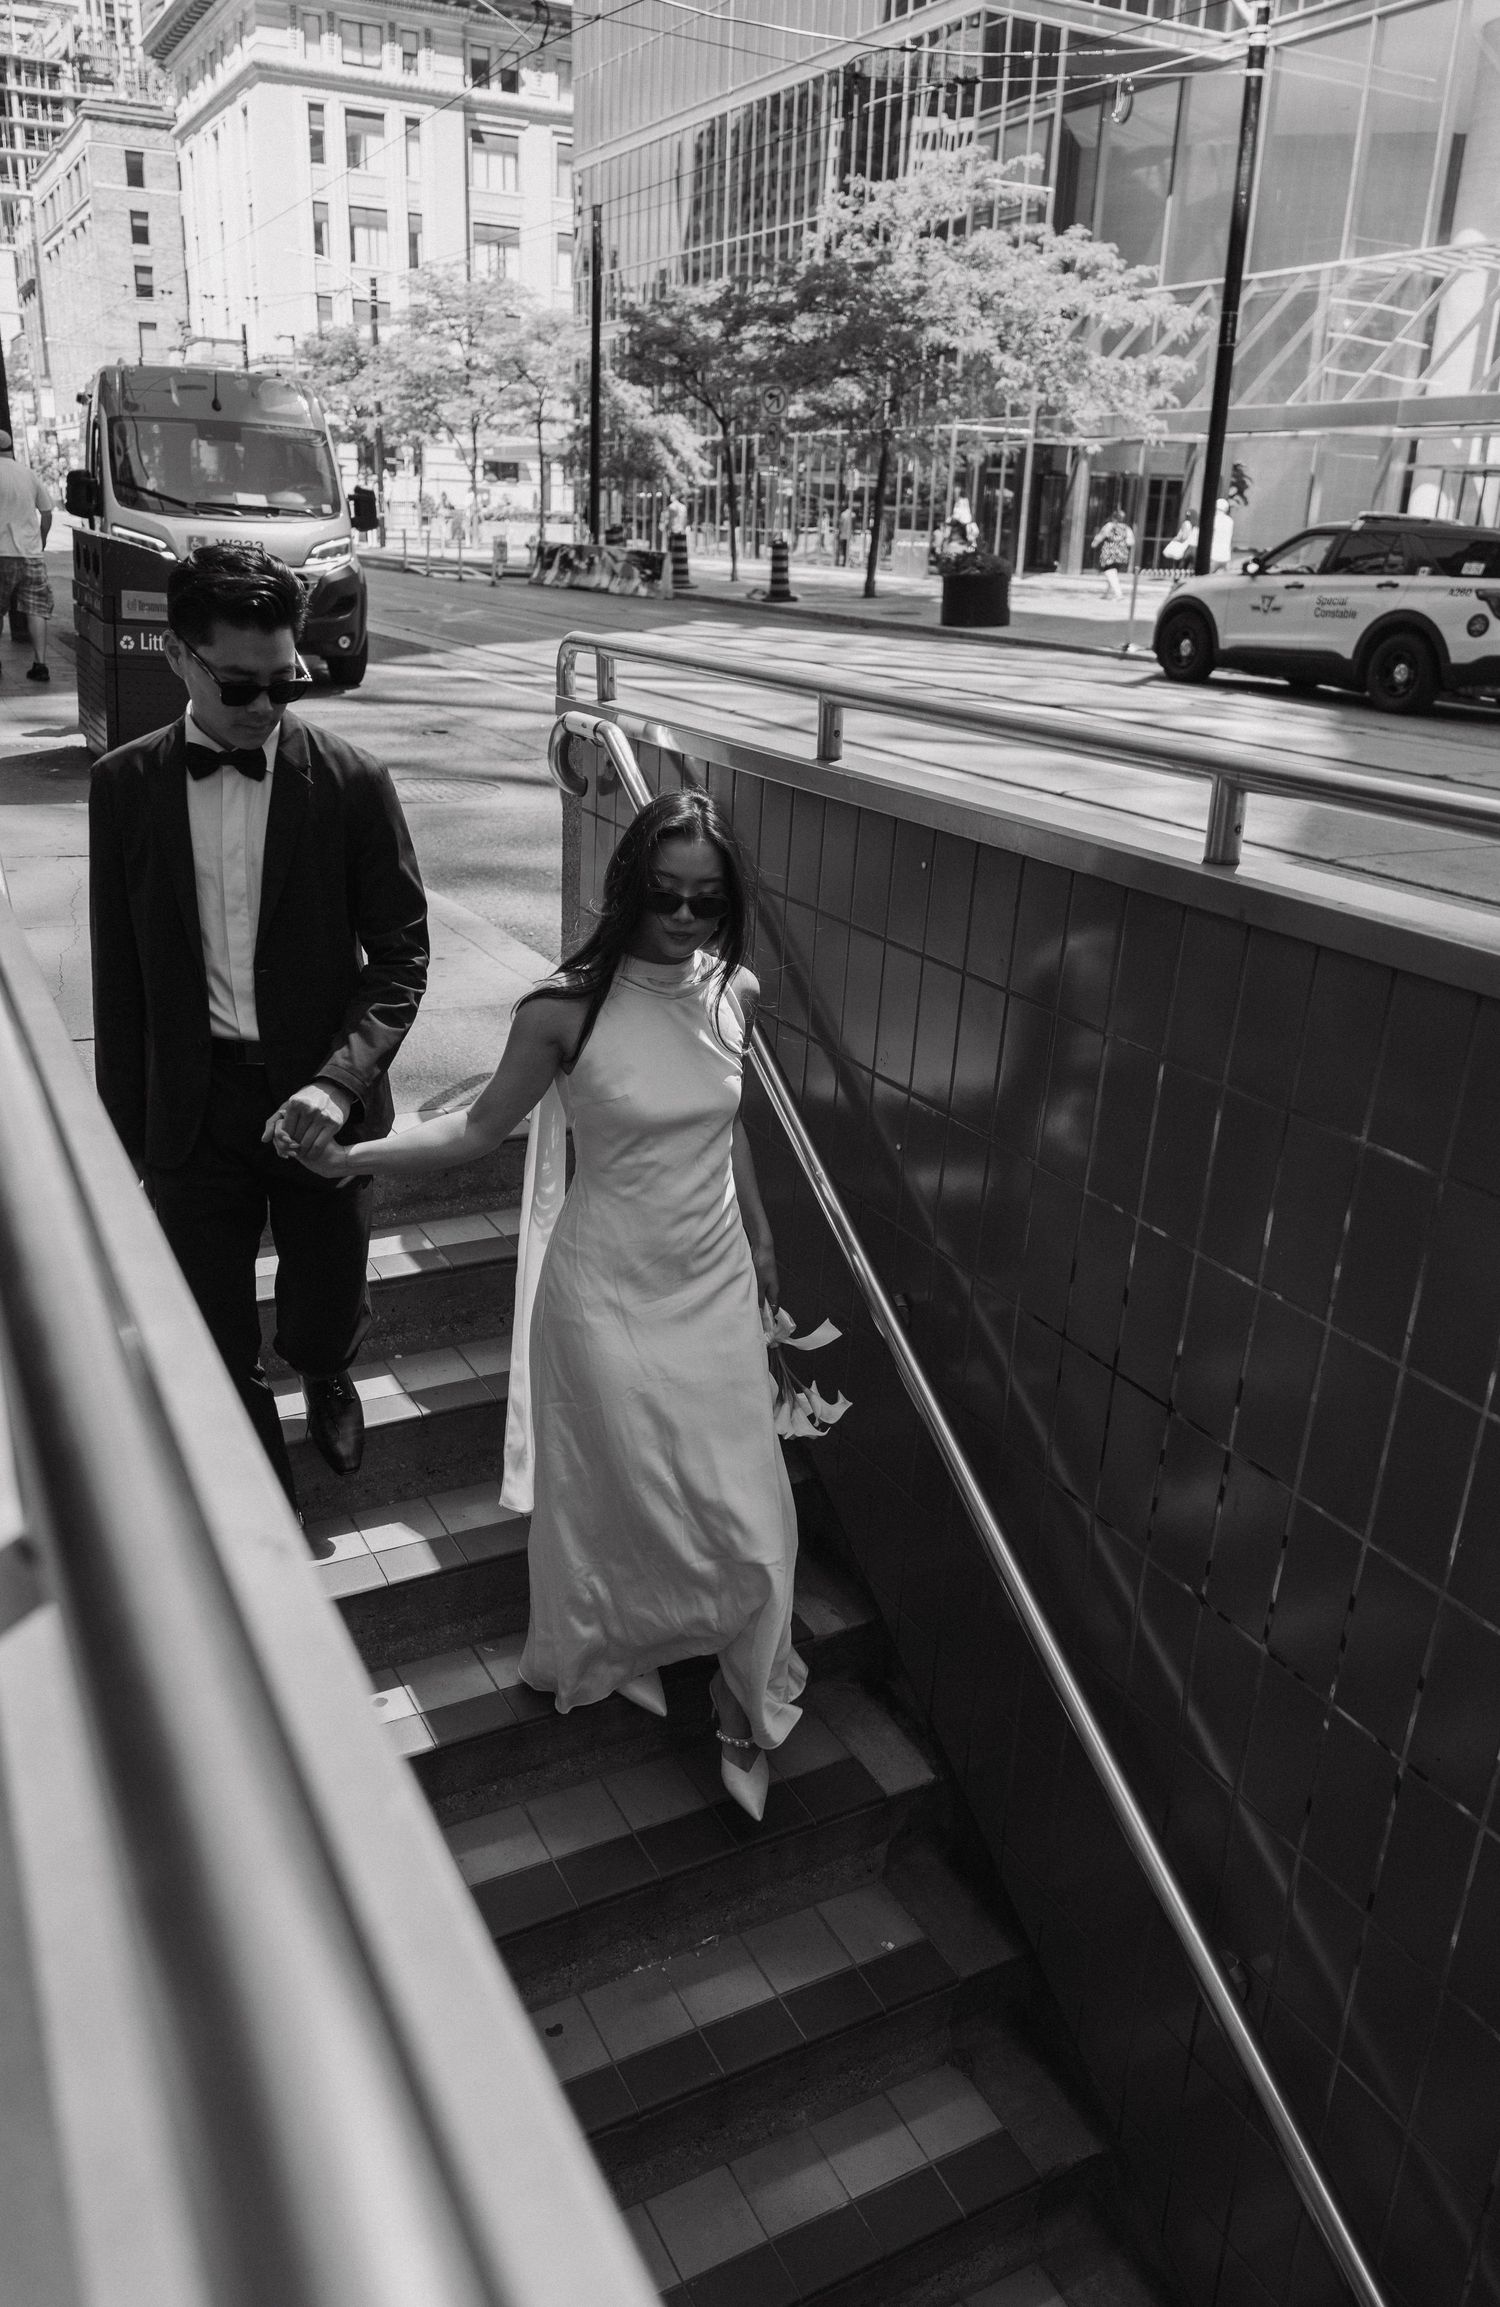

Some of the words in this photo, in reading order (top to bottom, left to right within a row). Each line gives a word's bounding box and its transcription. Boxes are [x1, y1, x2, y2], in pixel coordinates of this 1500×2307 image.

[1315, 596, 1348, 606] Special
[1313, 607, 1357, 618] Constable
[140, 632, 164, 651] Litt
